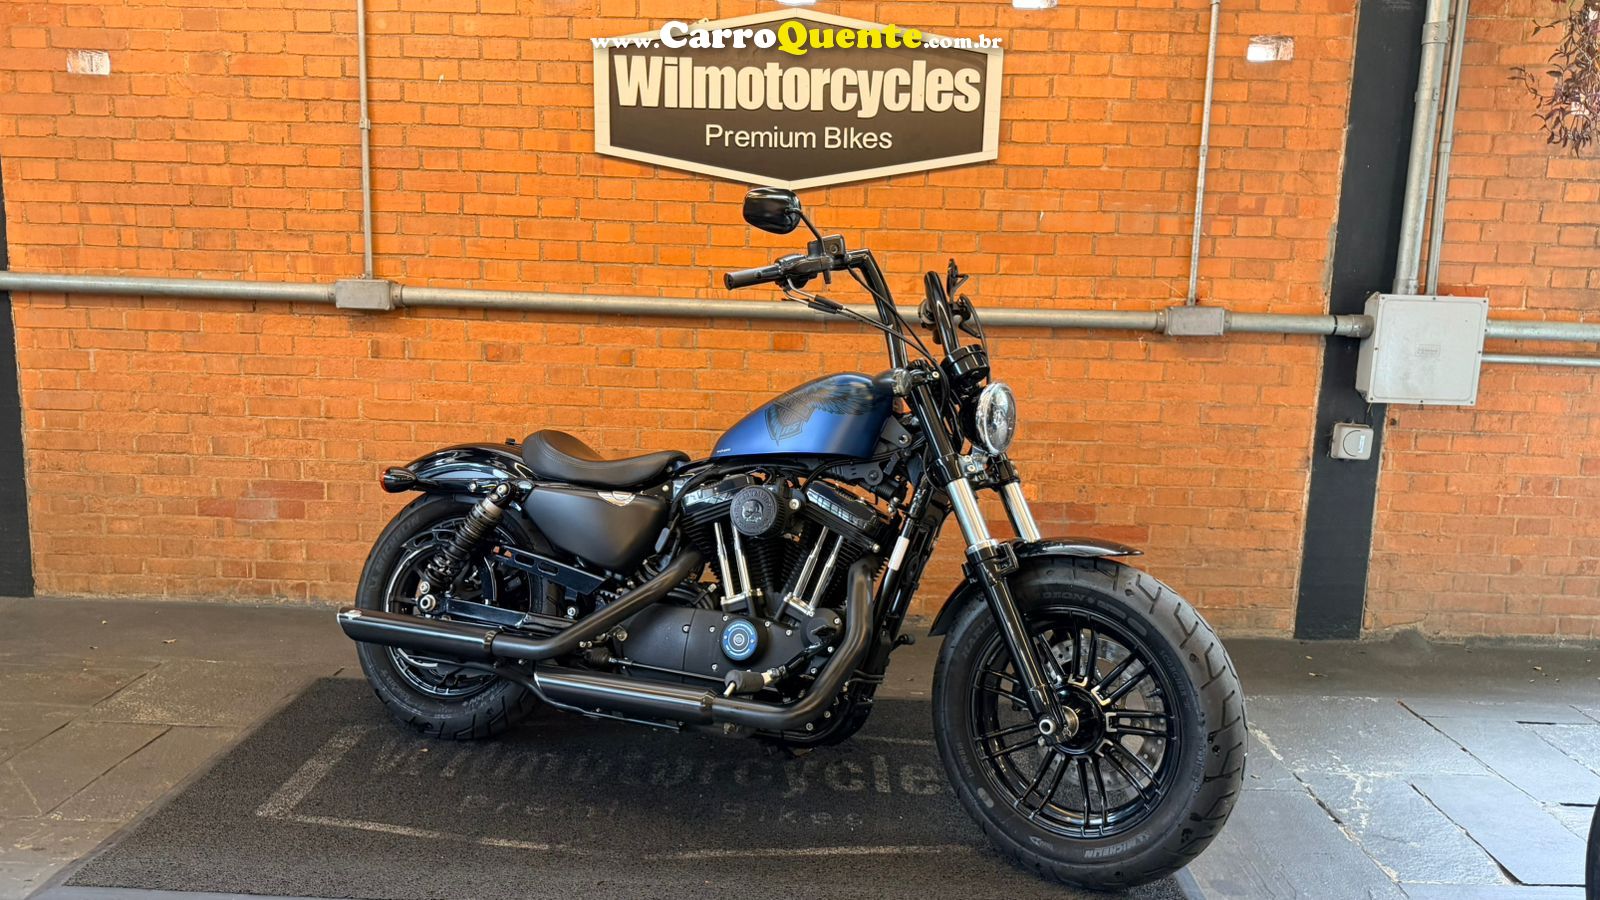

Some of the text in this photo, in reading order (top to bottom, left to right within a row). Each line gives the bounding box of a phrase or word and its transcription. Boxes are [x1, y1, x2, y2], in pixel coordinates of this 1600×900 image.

[613, 54, 981, 119] Wilmotorcycles
[705, 124, 816, 148] Premium
[1084, 837, 1138, 858] MICHELIN
